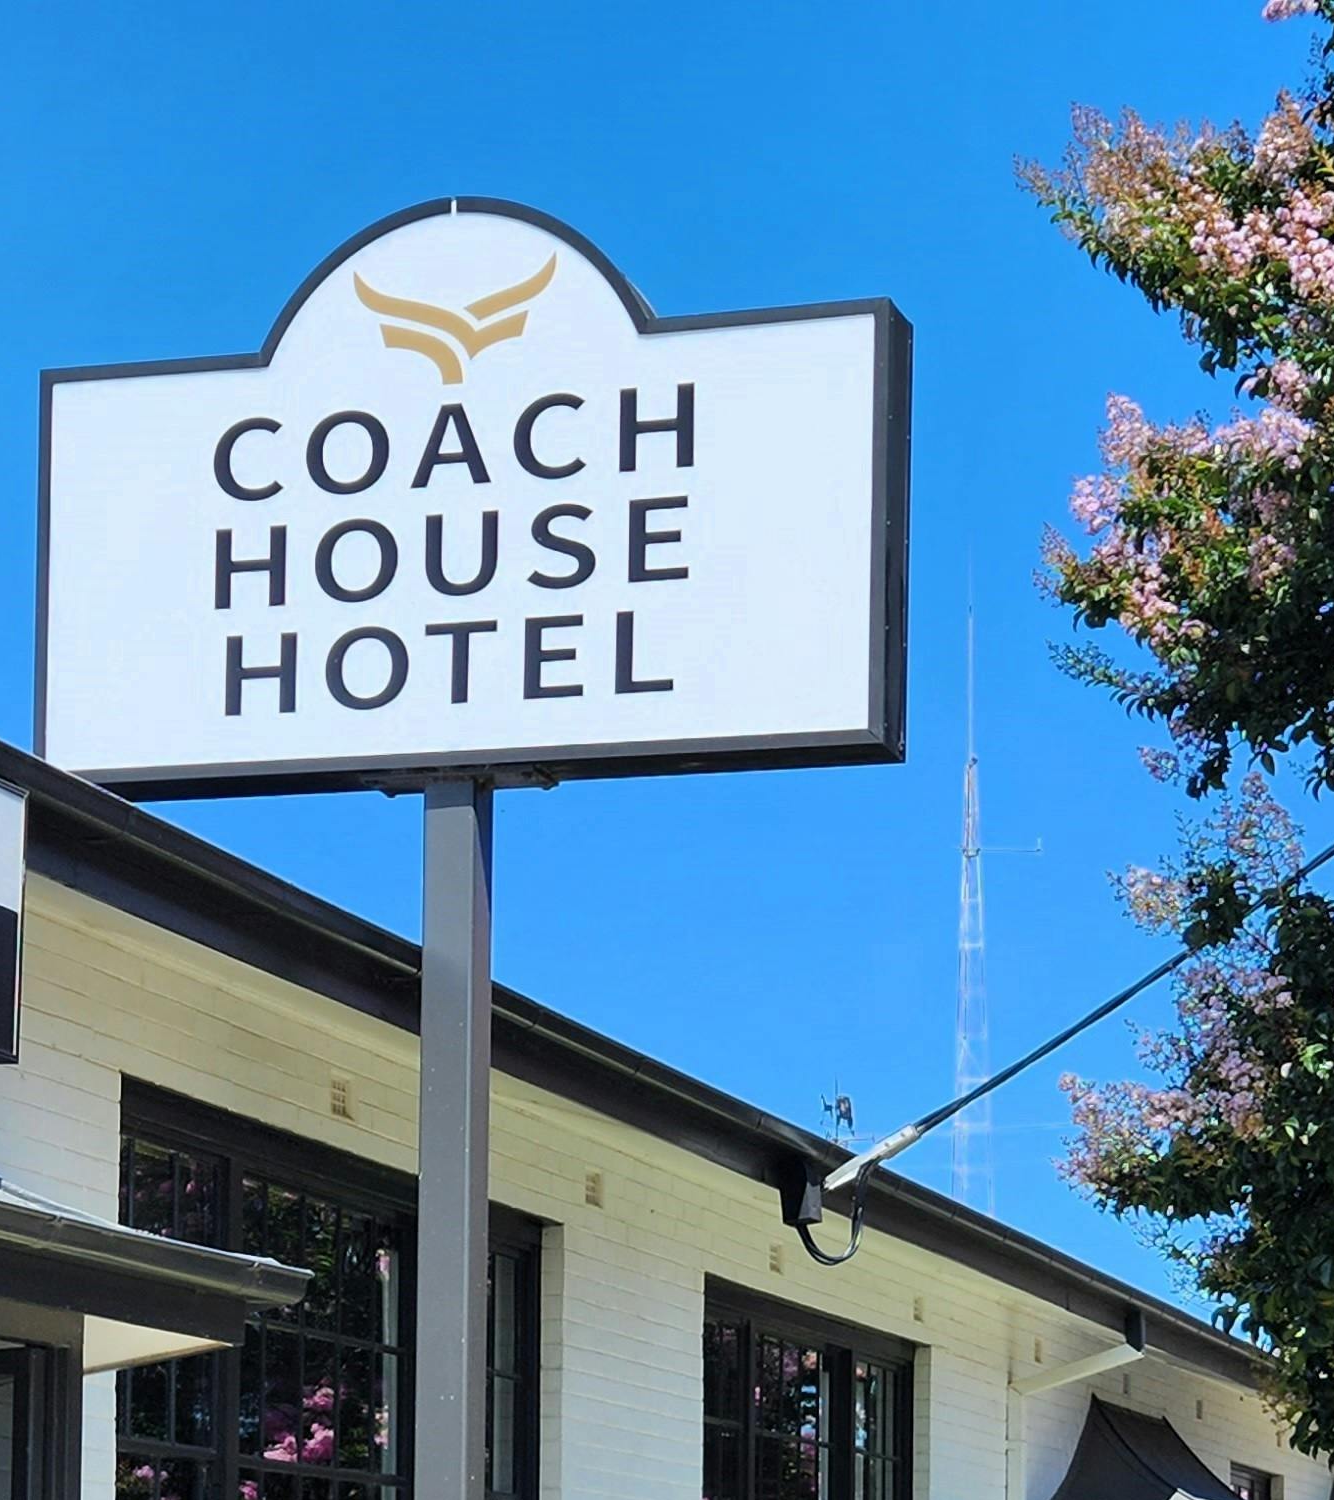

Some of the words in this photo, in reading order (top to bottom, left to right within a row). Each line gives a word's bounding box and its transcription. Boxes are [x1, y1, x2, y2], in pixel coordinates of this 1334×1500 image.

[213, 382, 696, 502] COACH
[214, 495, 690, 610] HOUSE
[224, 610, 675, 716] HOTEL
